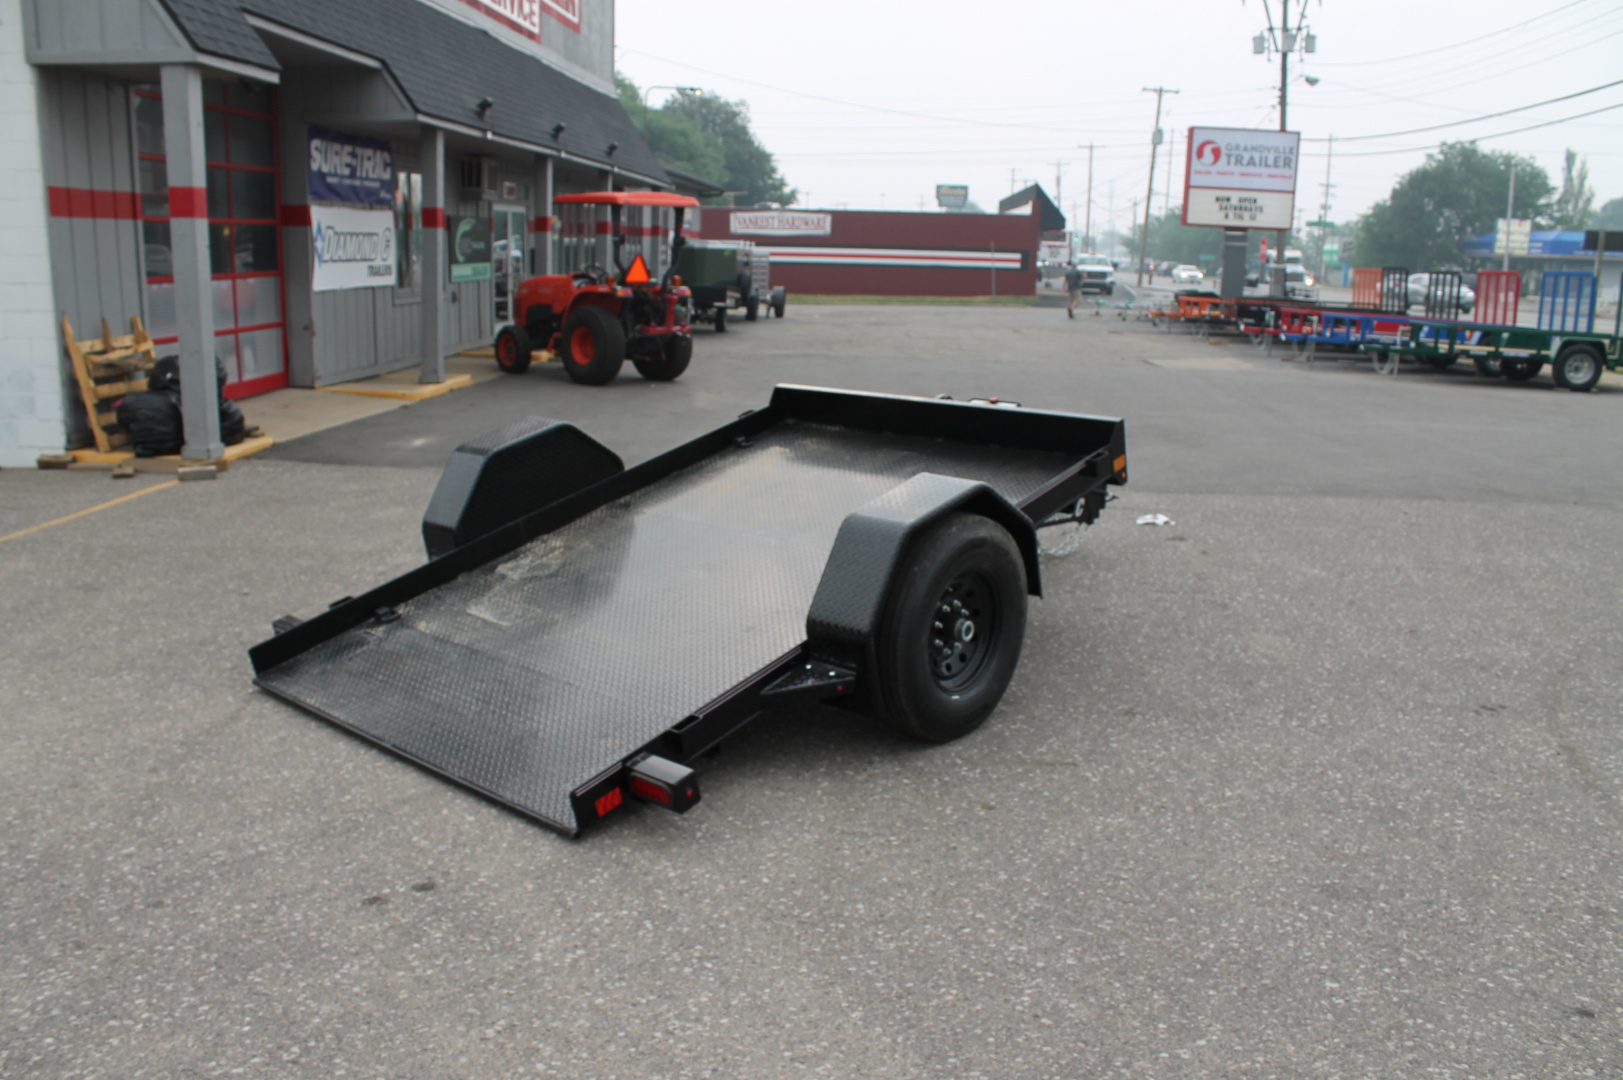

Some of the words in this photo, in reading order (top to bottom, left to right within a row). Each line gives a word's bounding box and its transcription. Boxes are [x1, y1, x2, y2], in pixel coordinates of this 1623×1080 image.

[1225, 143, 1295, 154] GRANDVILLE
[310, 138, 392, 180] SURE-TRAC
[1225, 153, 1293, 168] TRAILER
[322, 225, 380, 263] DIAMOND
[380, 226, 392, 262] C
[367, 264, 392, 277] TRAILERS
